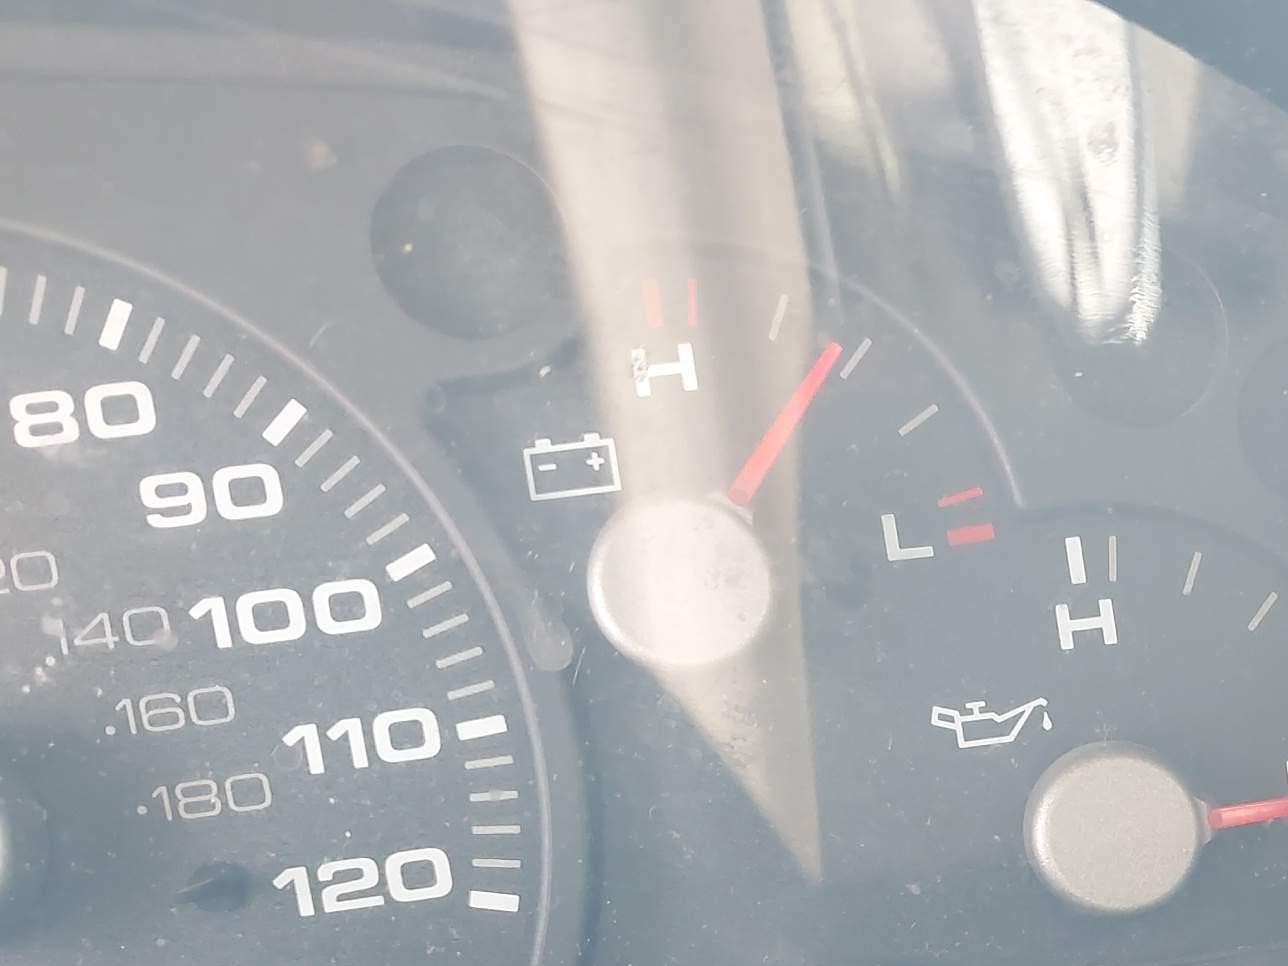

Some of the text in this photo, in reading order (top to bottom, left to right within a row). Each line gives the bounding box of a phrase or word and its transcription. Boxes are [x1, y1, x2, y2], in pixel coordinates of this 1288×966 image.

[631, 343, 698, 396] H
[10, 381, 157, 448] 80
[138, 463, 284, 528] 90
[881, 514, 934, 561] L
[46, 606, 173, 656] 140
[188, 578, 383, 649] 100
[1055, 598, 1118, 650] H
[114, 685, 236, 735] 160
[282, 707, 441, 775] 110
[152, 773, 272, 821] 180
[272, 847, 453, 917] 120
